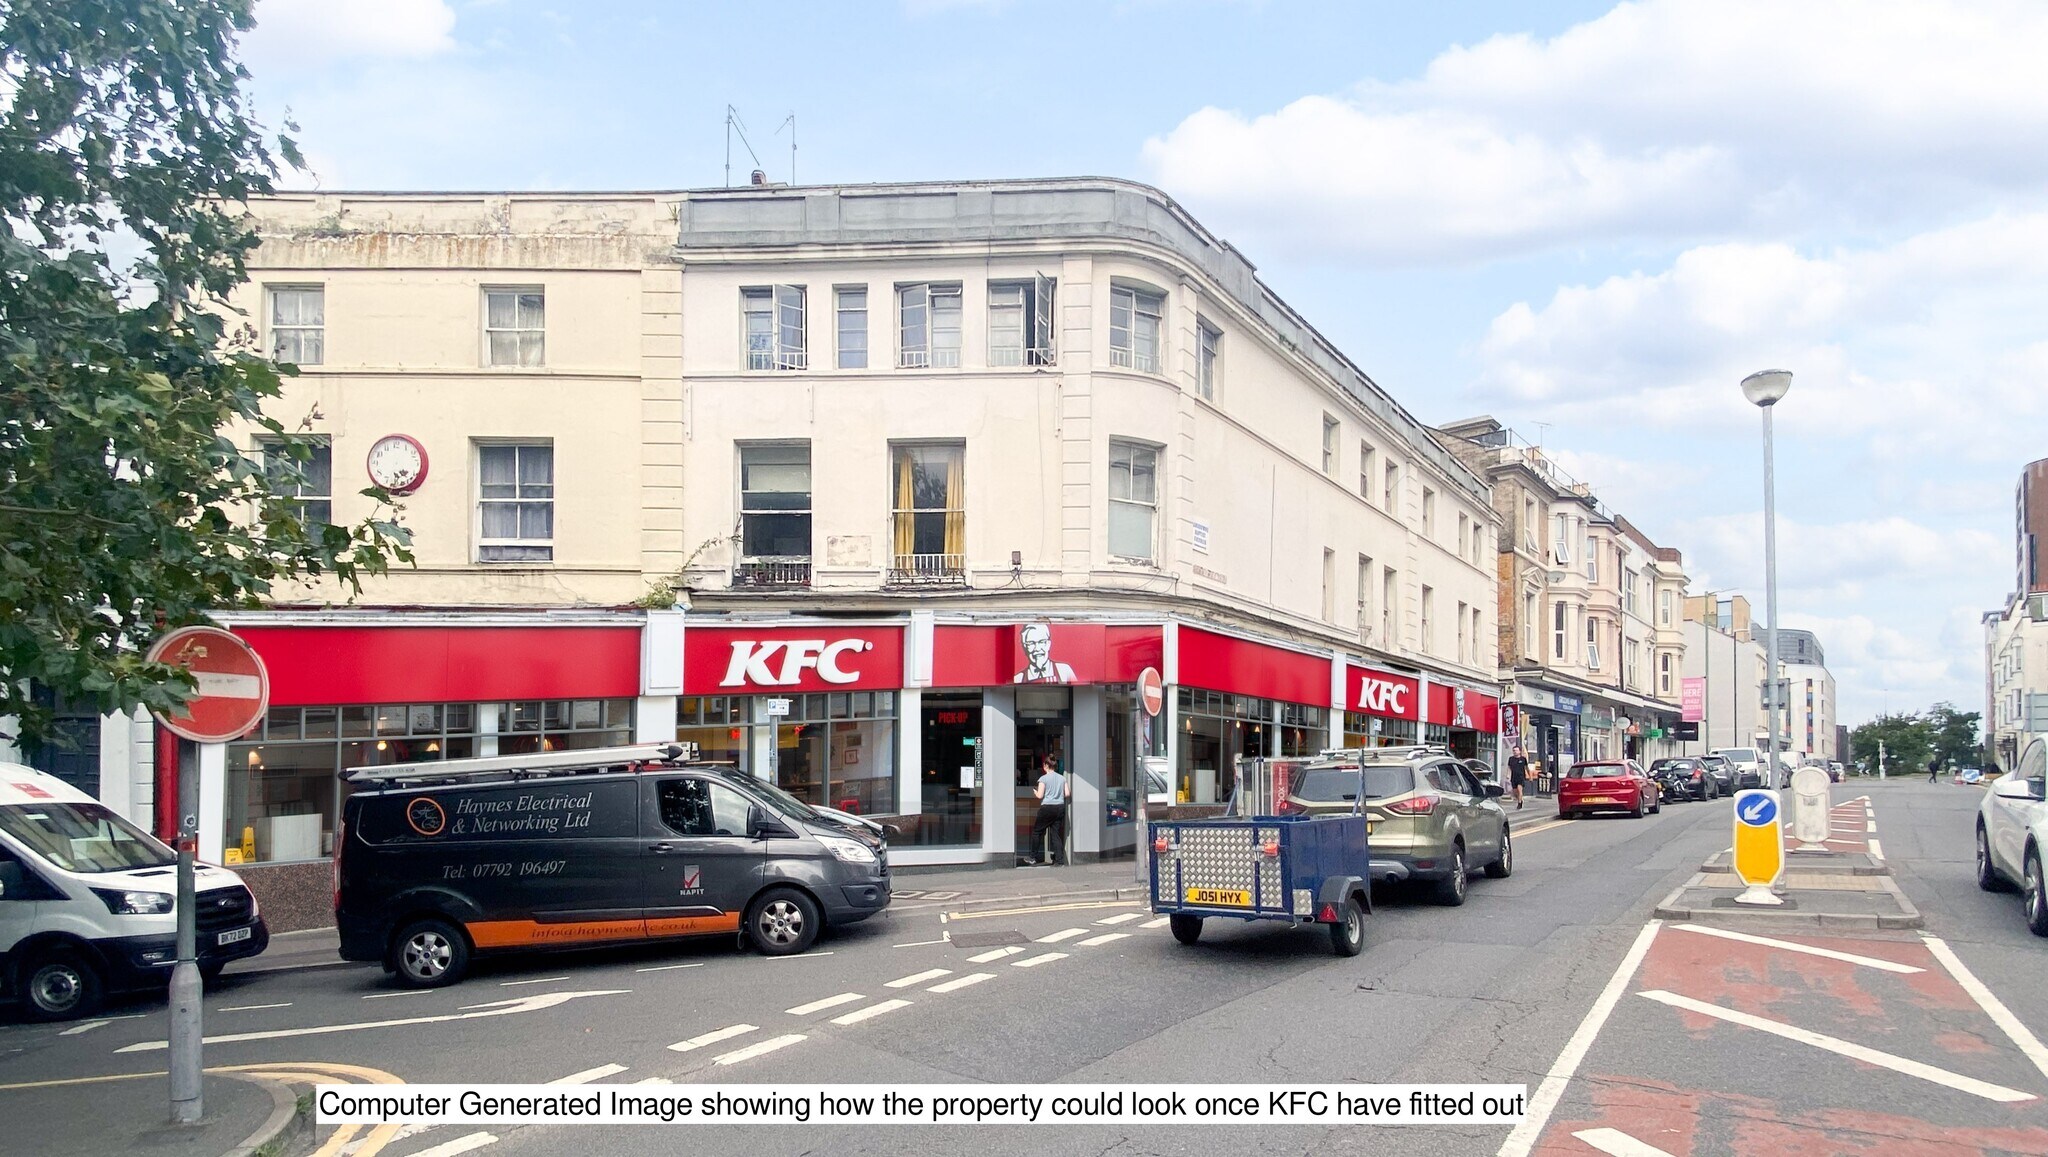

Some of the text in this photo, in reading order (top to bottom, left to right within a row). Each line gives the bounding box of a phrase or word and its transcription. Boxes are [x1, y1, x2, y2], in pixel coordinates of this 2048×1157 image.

[719, 638, 865, 687] KFC
[1357, 676, 1407, 714] KFC
[1682, 688, 1702, 698] HERE
[938, 712, 968, 724] PICK-UP
[456, 792, 593, 817] Haynes Electrical
[451, 811, 591, 834] & Networking Ltd
[473, 862, 513, 877] 07792
[519, 860, 567, 876] 196497
[679, 888, 705, 896] NAPIT
[1195, 891, 1241, 904] JO51 HYX
